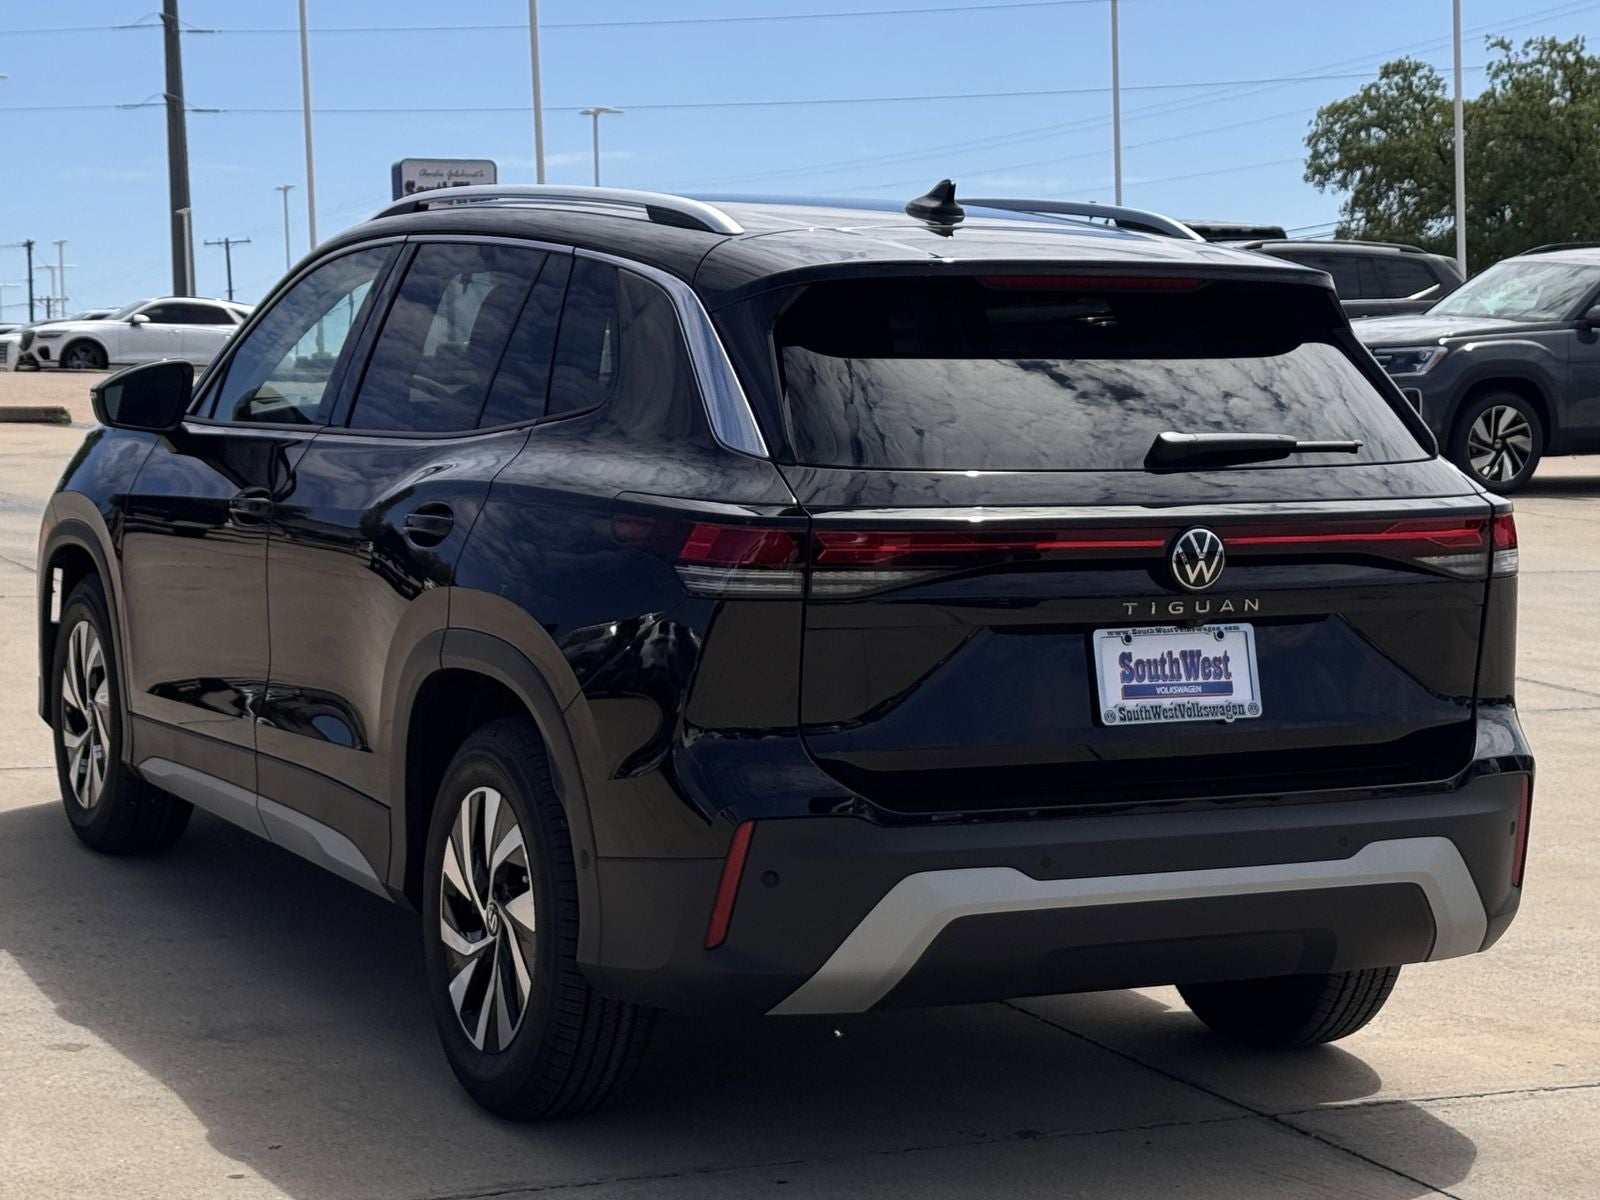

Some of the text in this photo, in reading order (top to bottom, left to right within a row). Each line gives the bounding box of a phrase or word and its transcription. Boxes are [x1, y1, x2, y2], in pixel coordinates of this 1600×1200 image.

[1172, 528, 1225, 589] VW
[1122, 598, 1259, 615] TIGUAN
[1118, 649, 1232, 683] SouthWest
[1156, 685, 1202, 695] VOLKSWAGEN
[1118, 702, 1246, 722] SouthWestVolkswagen
